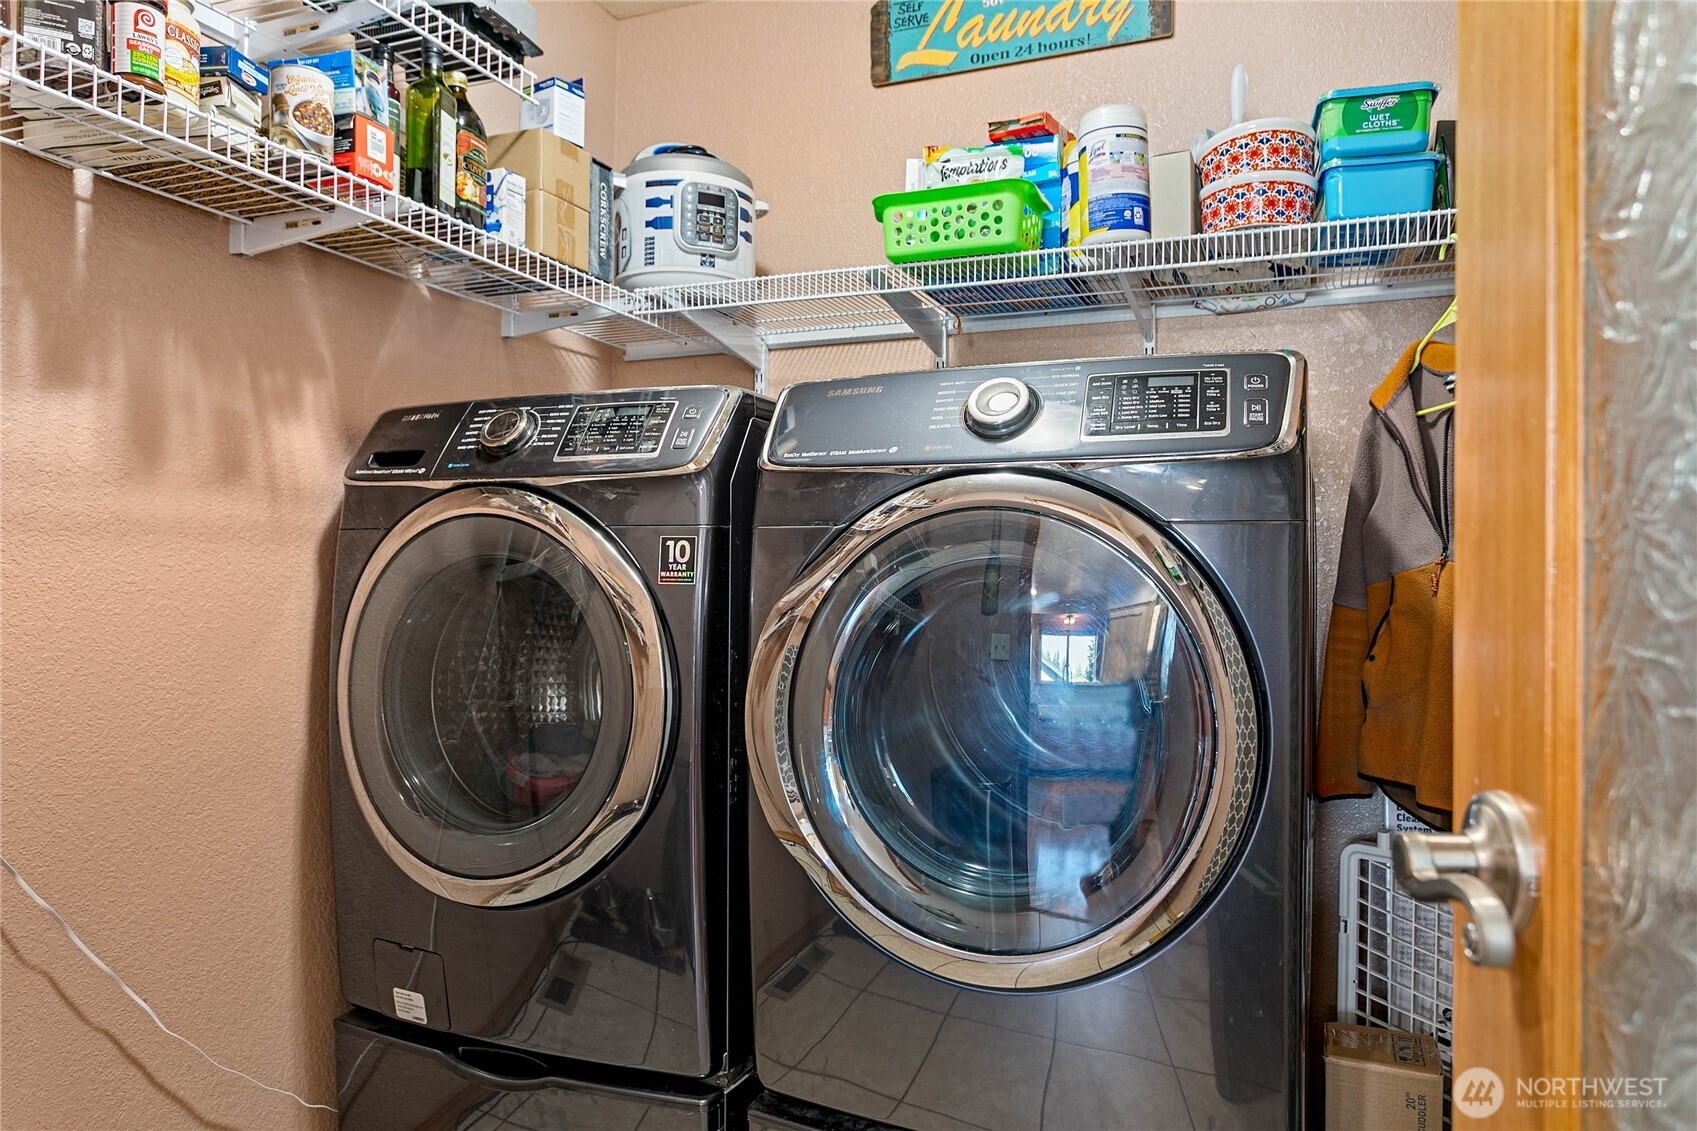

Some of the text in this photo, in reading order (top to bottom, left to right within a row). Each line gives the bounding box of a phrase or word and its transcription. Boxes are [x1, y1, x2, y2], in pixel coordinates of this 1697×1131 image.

[898, 1, 924, 14] SELF
[894, 12, 929, 28] SERVE
[896, 0, 1135, 72] Laundry
[970, 33, 1091, 64] Open 24 hours!
[1362, 98, 1398, 110] Swiffer
[1362, 120, 1397, 128] CLOTHS
[940, 157, 1008, 182] Temptations
[600, 182, 608, 260] CORKSCREW
[826, 386, 884, 397] SAMSUNG
[666, 540, 690, 563] 10
[1397, 814, 1420, 822] Clea
[1397, 824, 1432, 832] System
[1406, 1092, 1416, 1110] 20"
